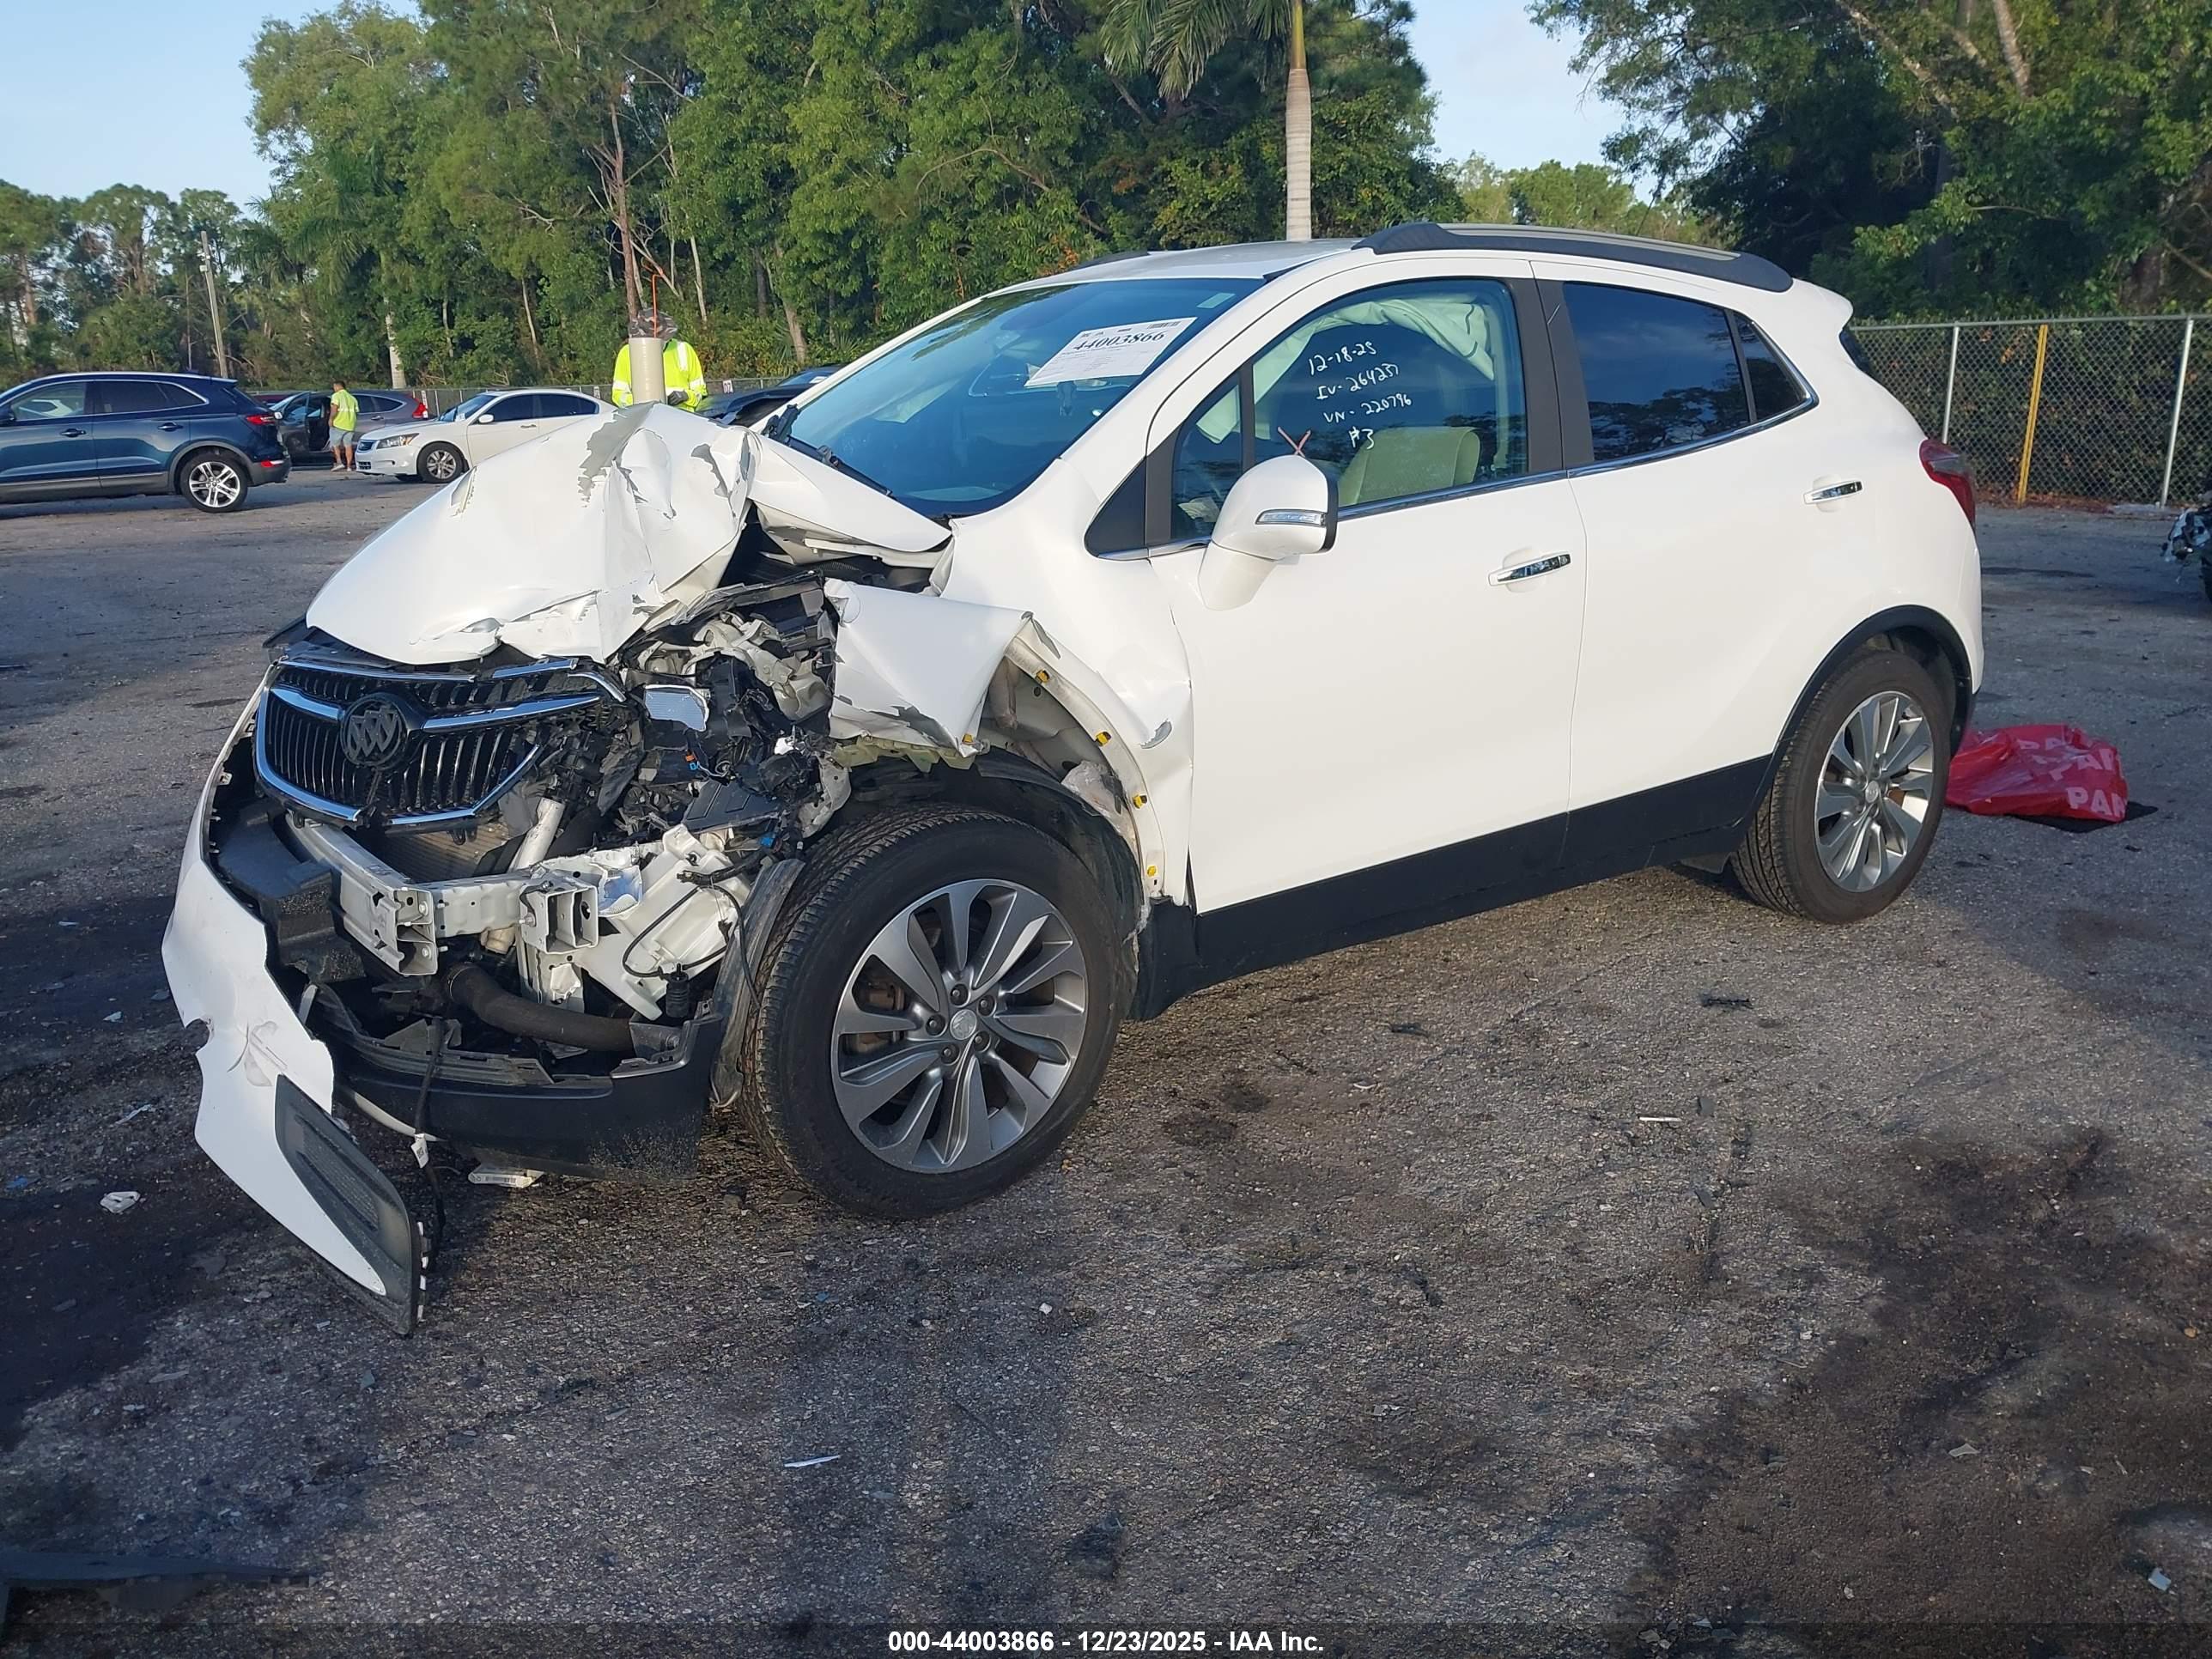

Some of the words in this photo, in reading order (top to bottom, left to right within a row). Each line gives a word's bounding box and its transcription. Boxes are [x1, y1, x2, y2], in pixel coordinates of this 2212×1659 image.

[1073, 331, 1168, 350] 44003866
[1309, 341, 1376, 375] 12-18-25
[1361, 393, 1412, 414] 220796
